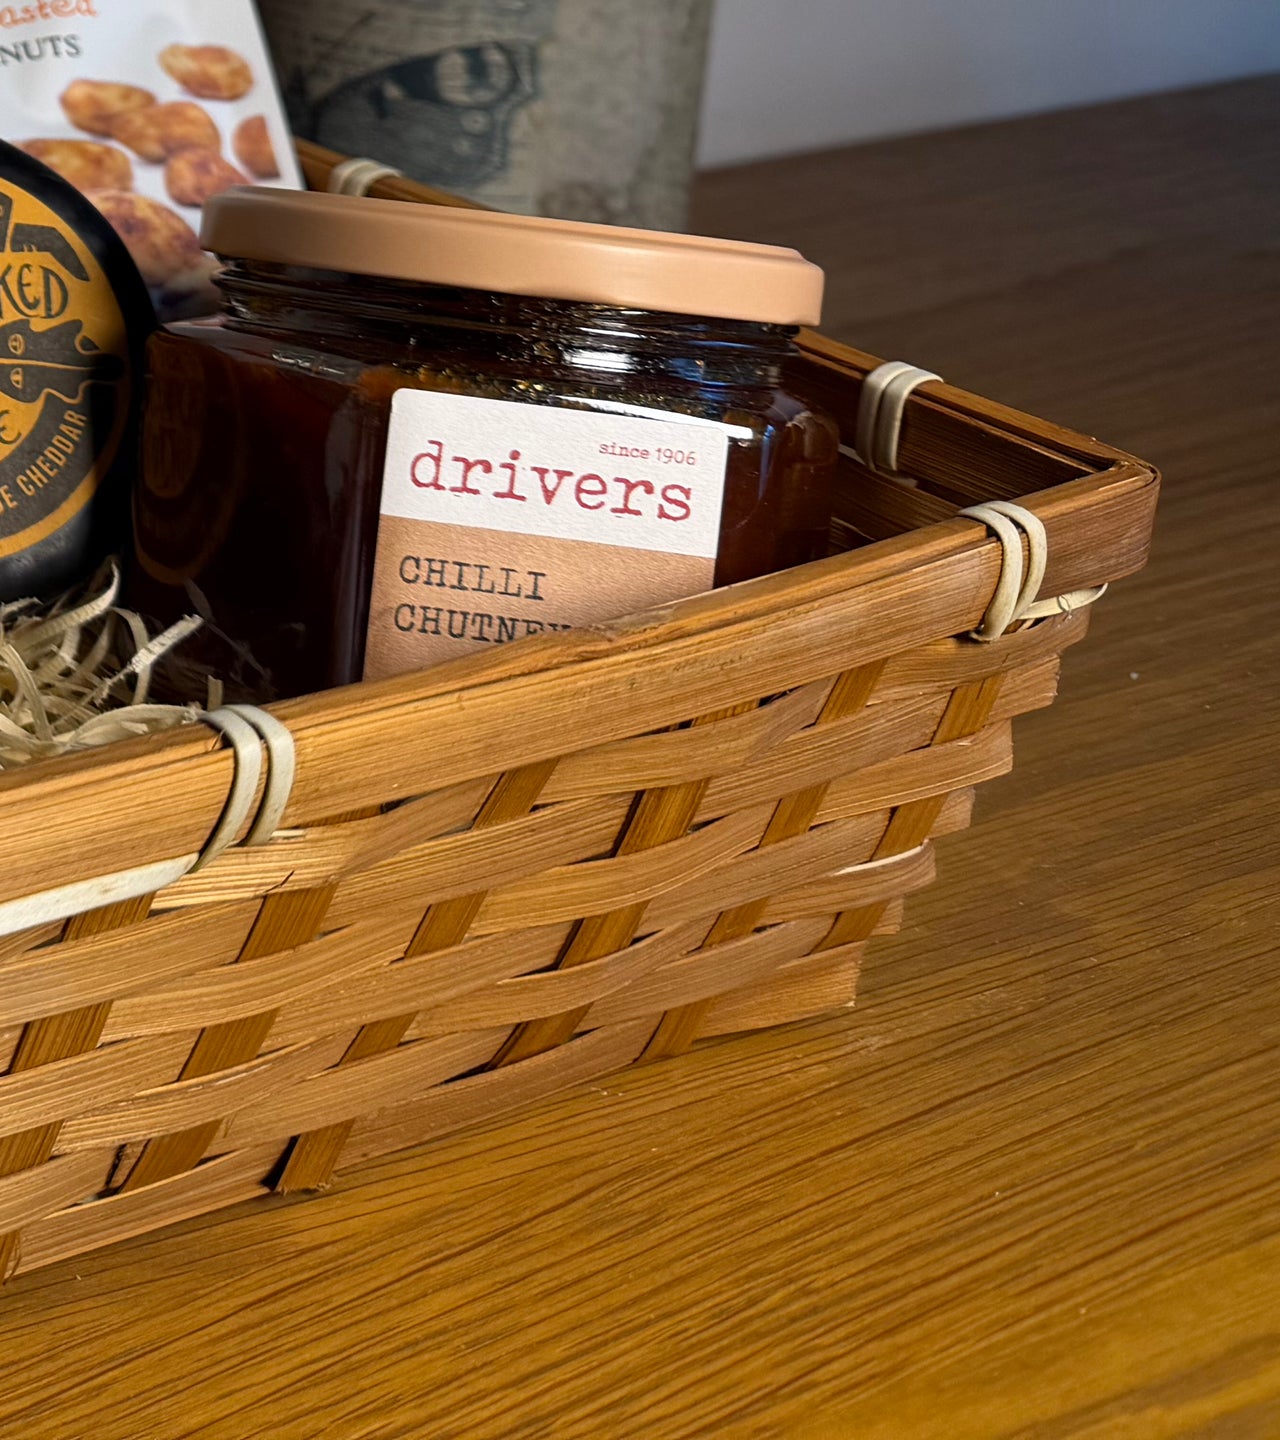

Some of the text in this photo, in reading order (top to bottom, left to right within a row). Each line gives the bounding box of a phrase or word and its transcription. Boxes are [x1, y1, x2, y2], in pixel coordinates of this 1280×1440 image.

[15, 409, 88, 498] CHEDDAR
[409, 439, 693, 522] drivers
[599, 442, 697, 467] since 1906
[398, 555, 547, 601] CHILLI
